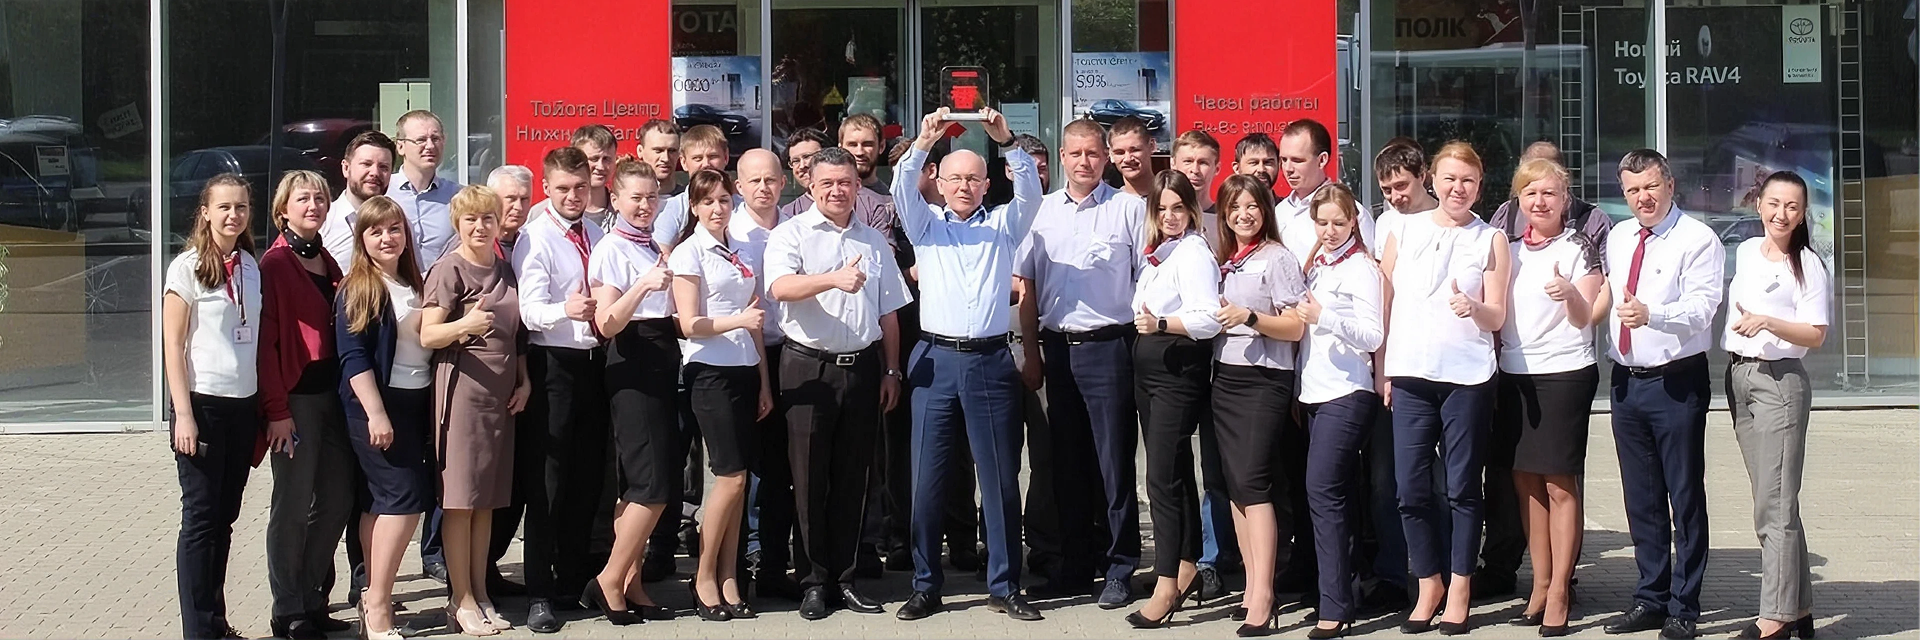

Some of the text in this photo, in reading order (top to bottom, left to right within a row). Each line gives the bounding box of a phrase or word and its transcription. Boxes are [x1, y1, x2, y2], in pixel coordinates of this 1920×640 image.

[1395, 17, 1466, 38] ПОЛК
[1614, 66, 1741, 88] Toyta RAV4
[531, 100, 661, 119] Тойота Центр
[1193, 94, 1319, 115] Часы работы
